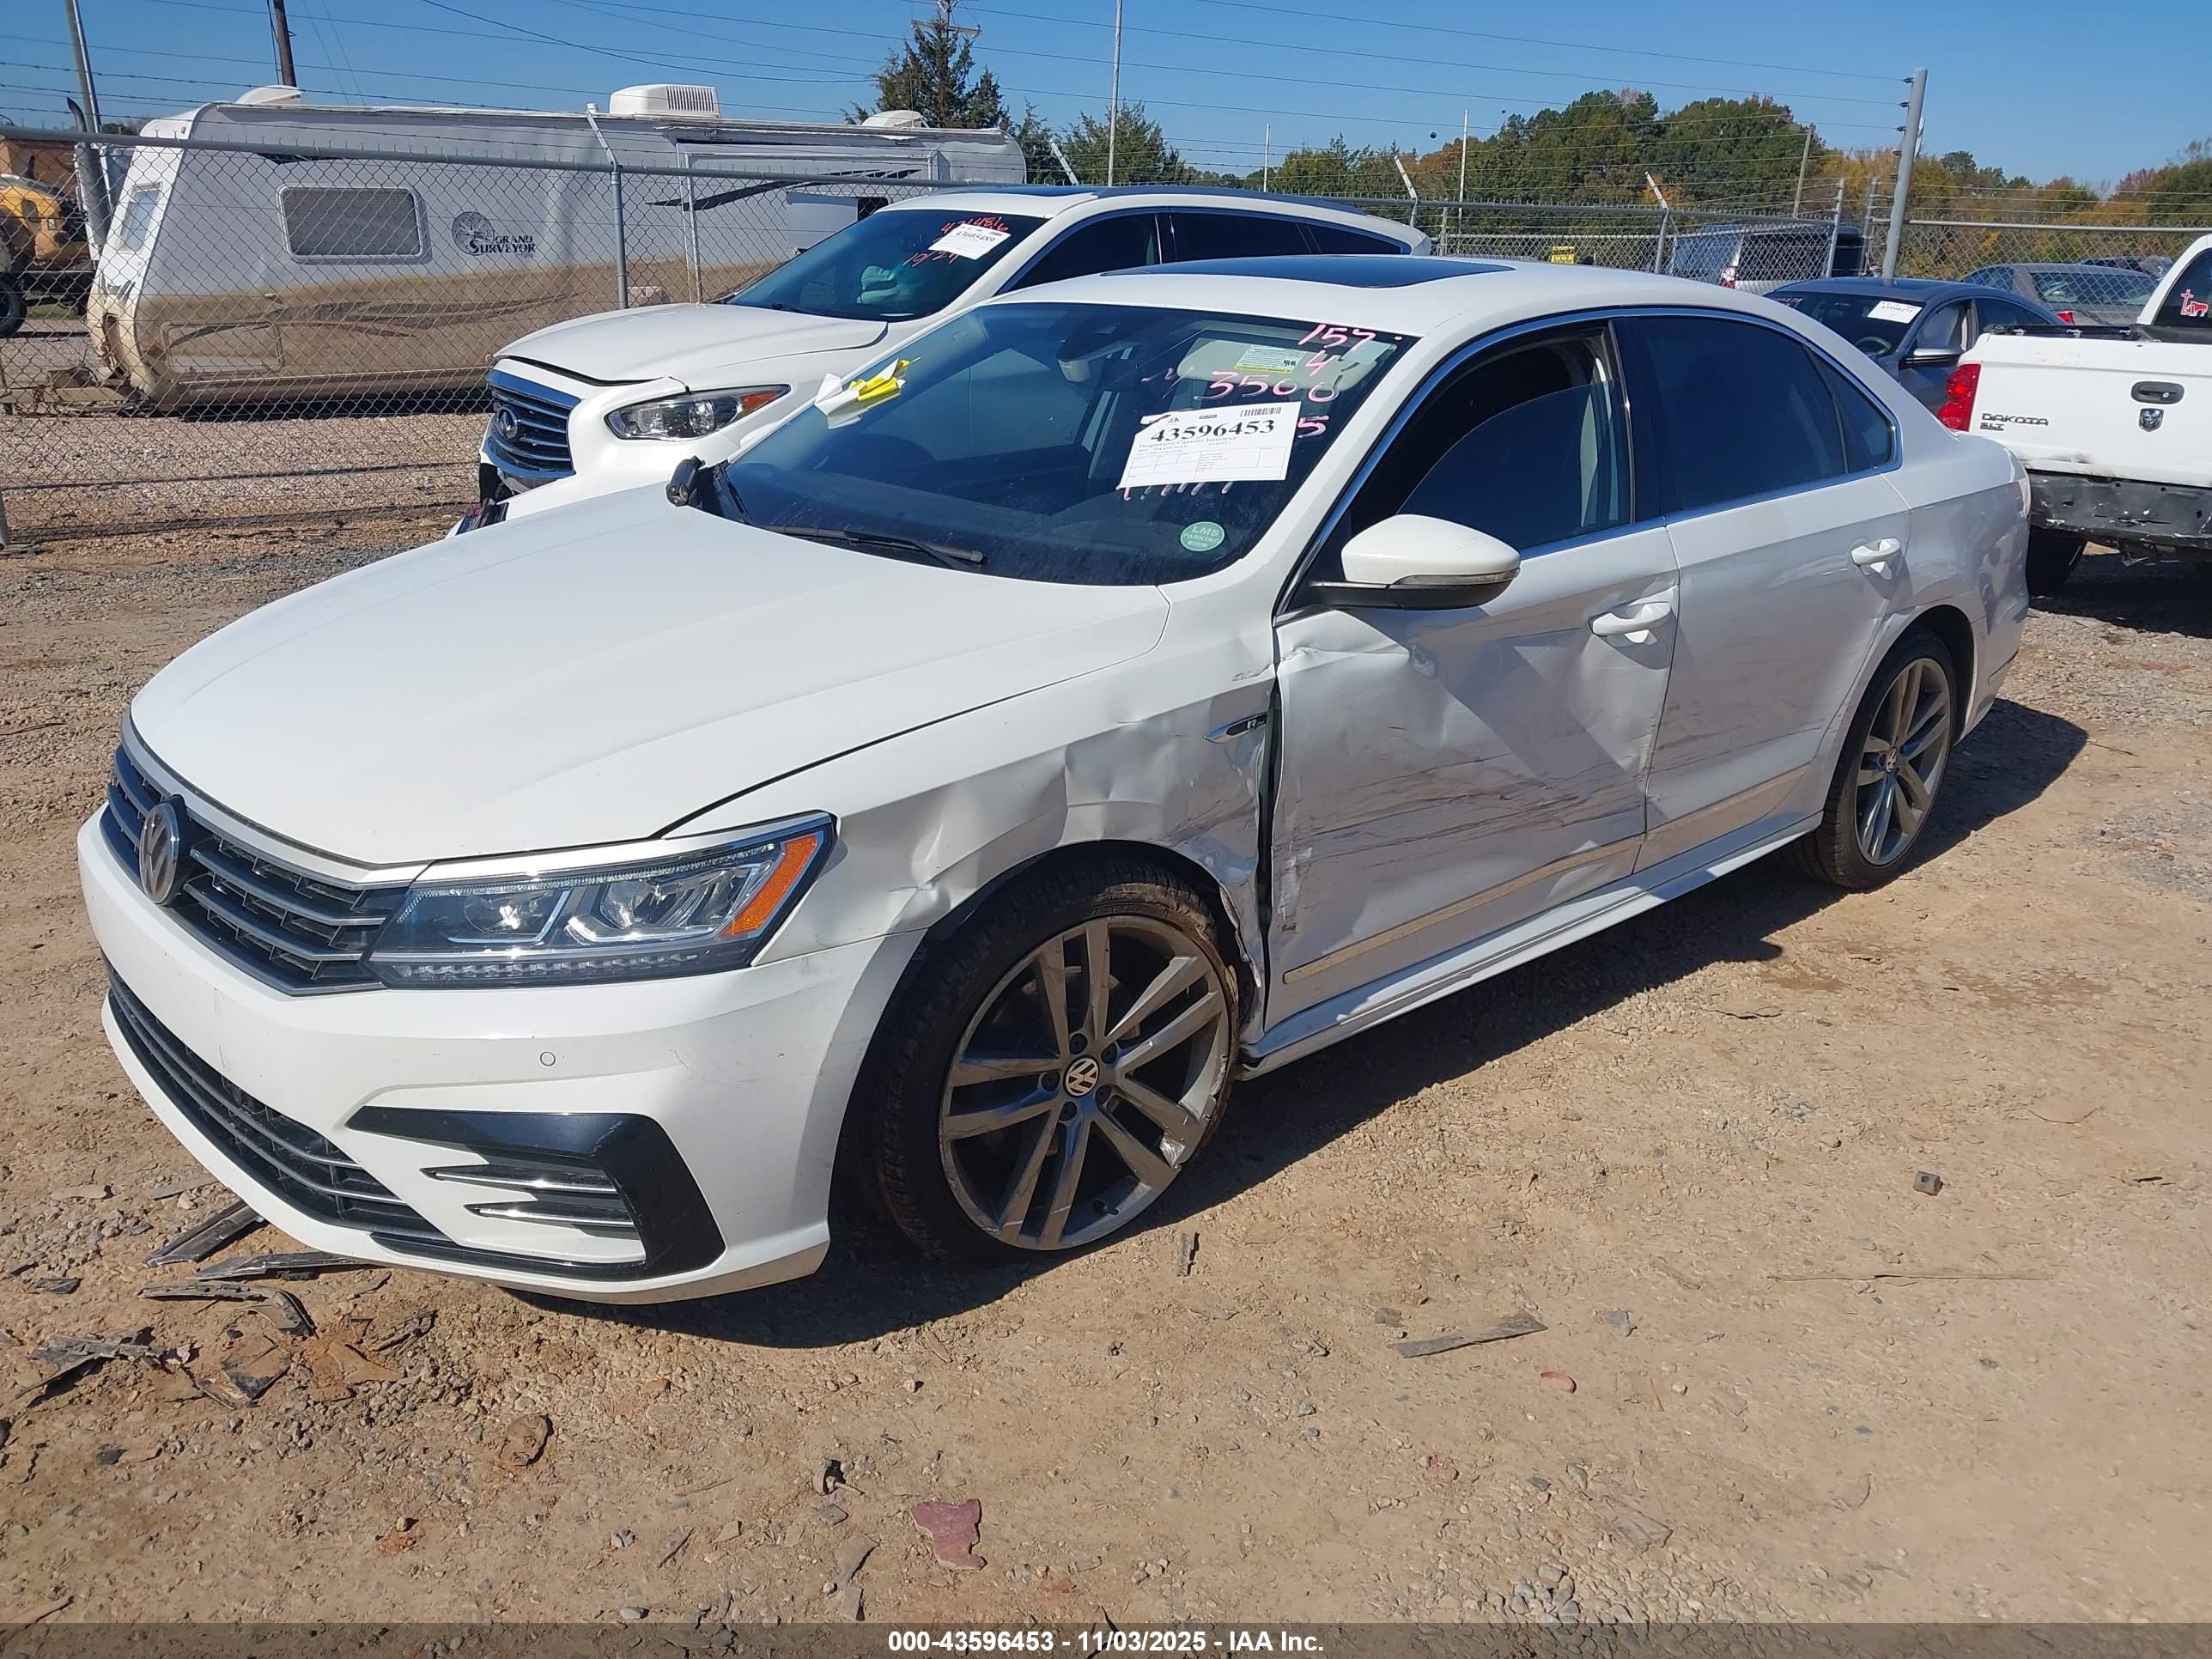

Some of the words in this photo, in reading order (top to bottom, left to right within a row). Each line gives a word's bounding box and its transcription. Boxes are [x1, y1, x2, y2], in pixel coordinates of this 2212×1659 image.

[469, 240, 536, 254] SURVEYOR
[1981, 412, 2049, 427] DAKOTA
[1151, 419, 1275, 442] 43596453
